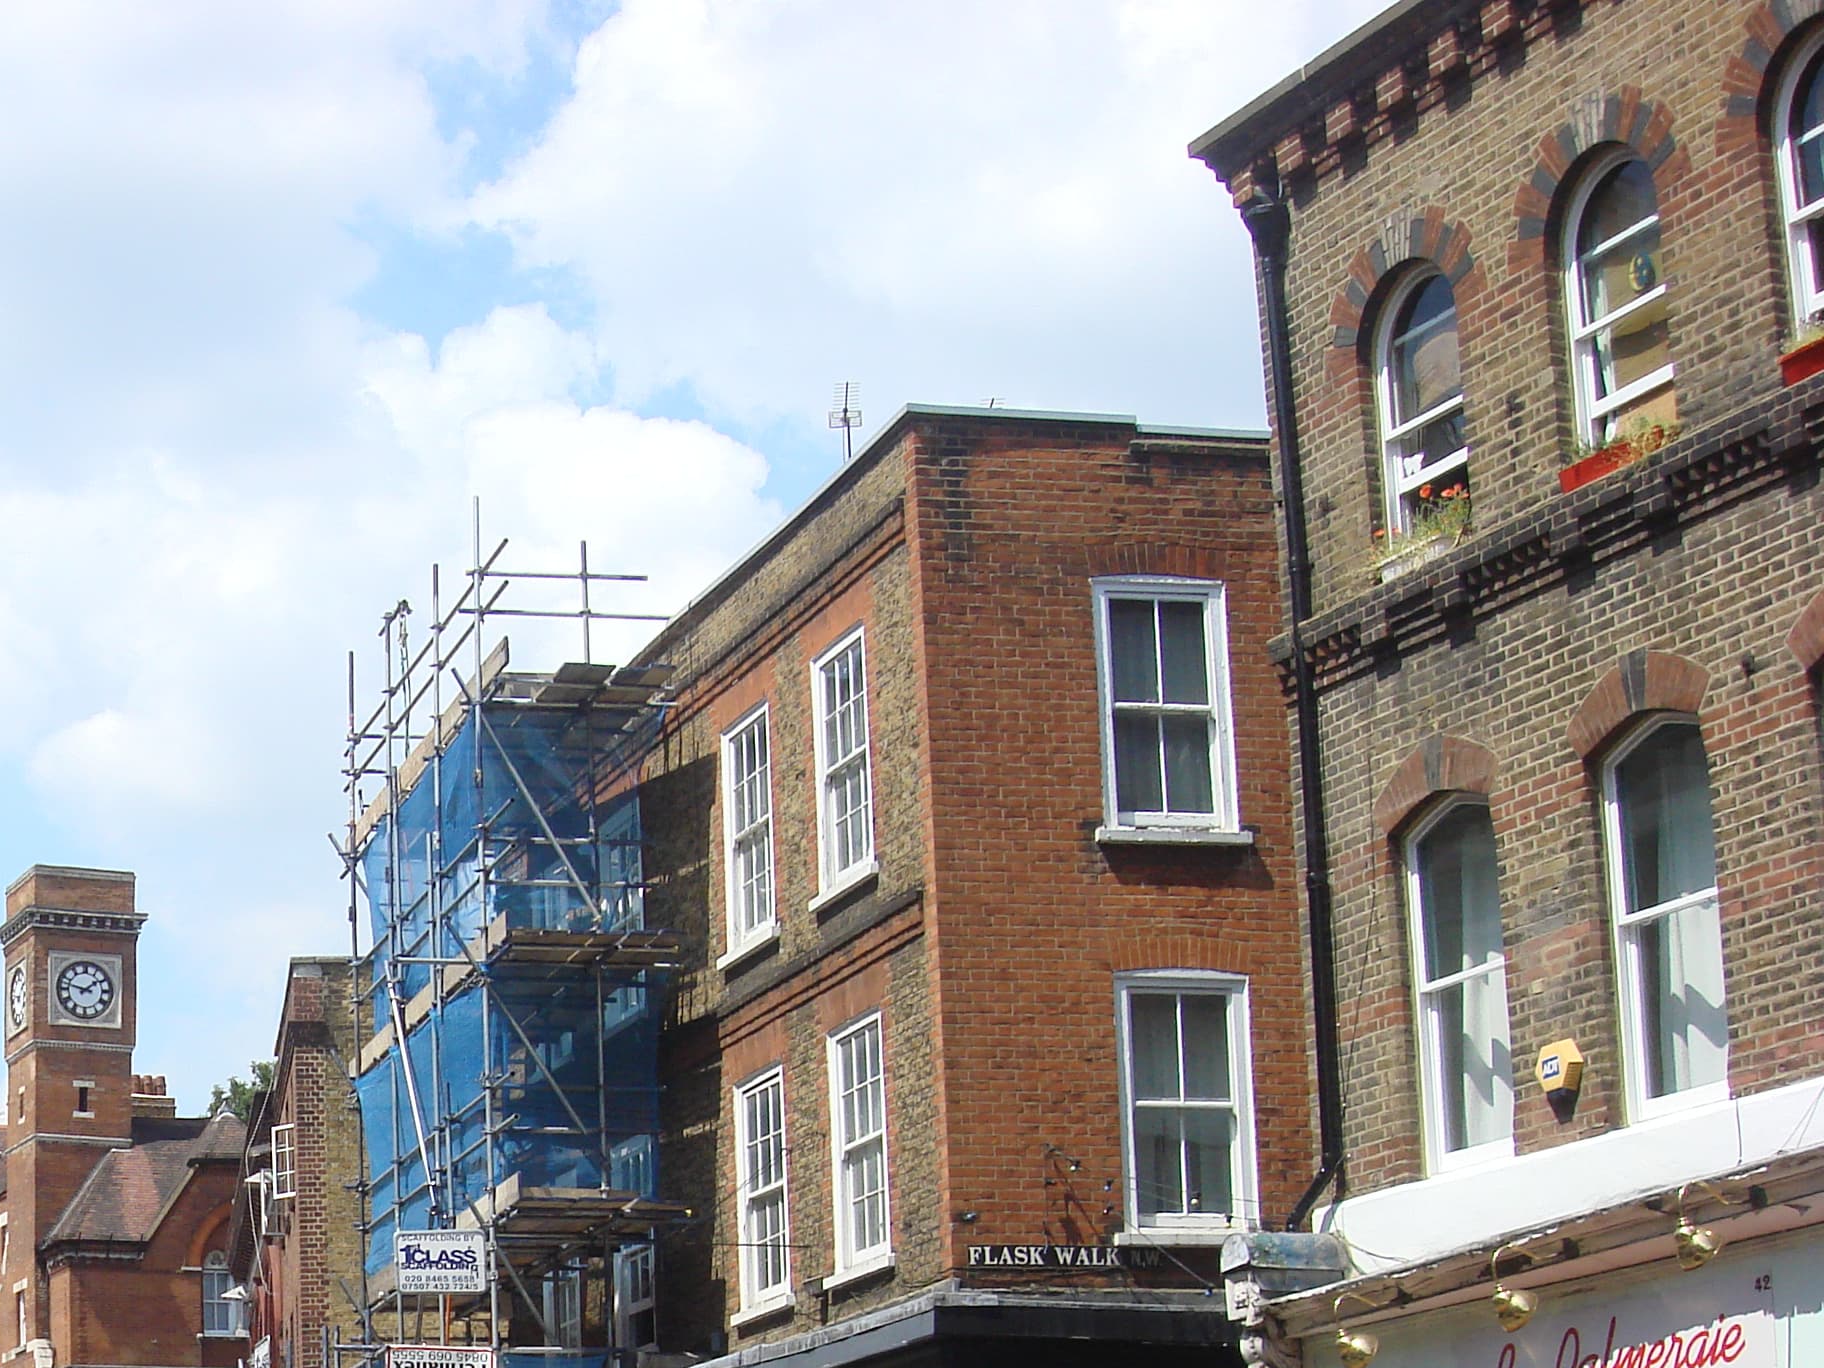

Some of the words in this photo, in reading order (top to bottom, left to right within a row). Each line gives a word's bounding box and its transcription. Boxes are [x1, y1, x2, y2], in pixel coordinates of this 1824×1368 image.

[402, 1234, 461, 1242] SCAFFOLDING
[464, 1234, 476, 1242] BY
[969, 1246, 1044, 1265] FLASK
[1055, 1246, 1120, 1266] WALK
[405, 1275, 422, 1283] 020
[1754, 1275, 1772, 1291] 42
[392, 1350, 424, 1361] 5555
[428, 1351, 453, 1362] 069
[456, 1352, 488, 1363] 0845
